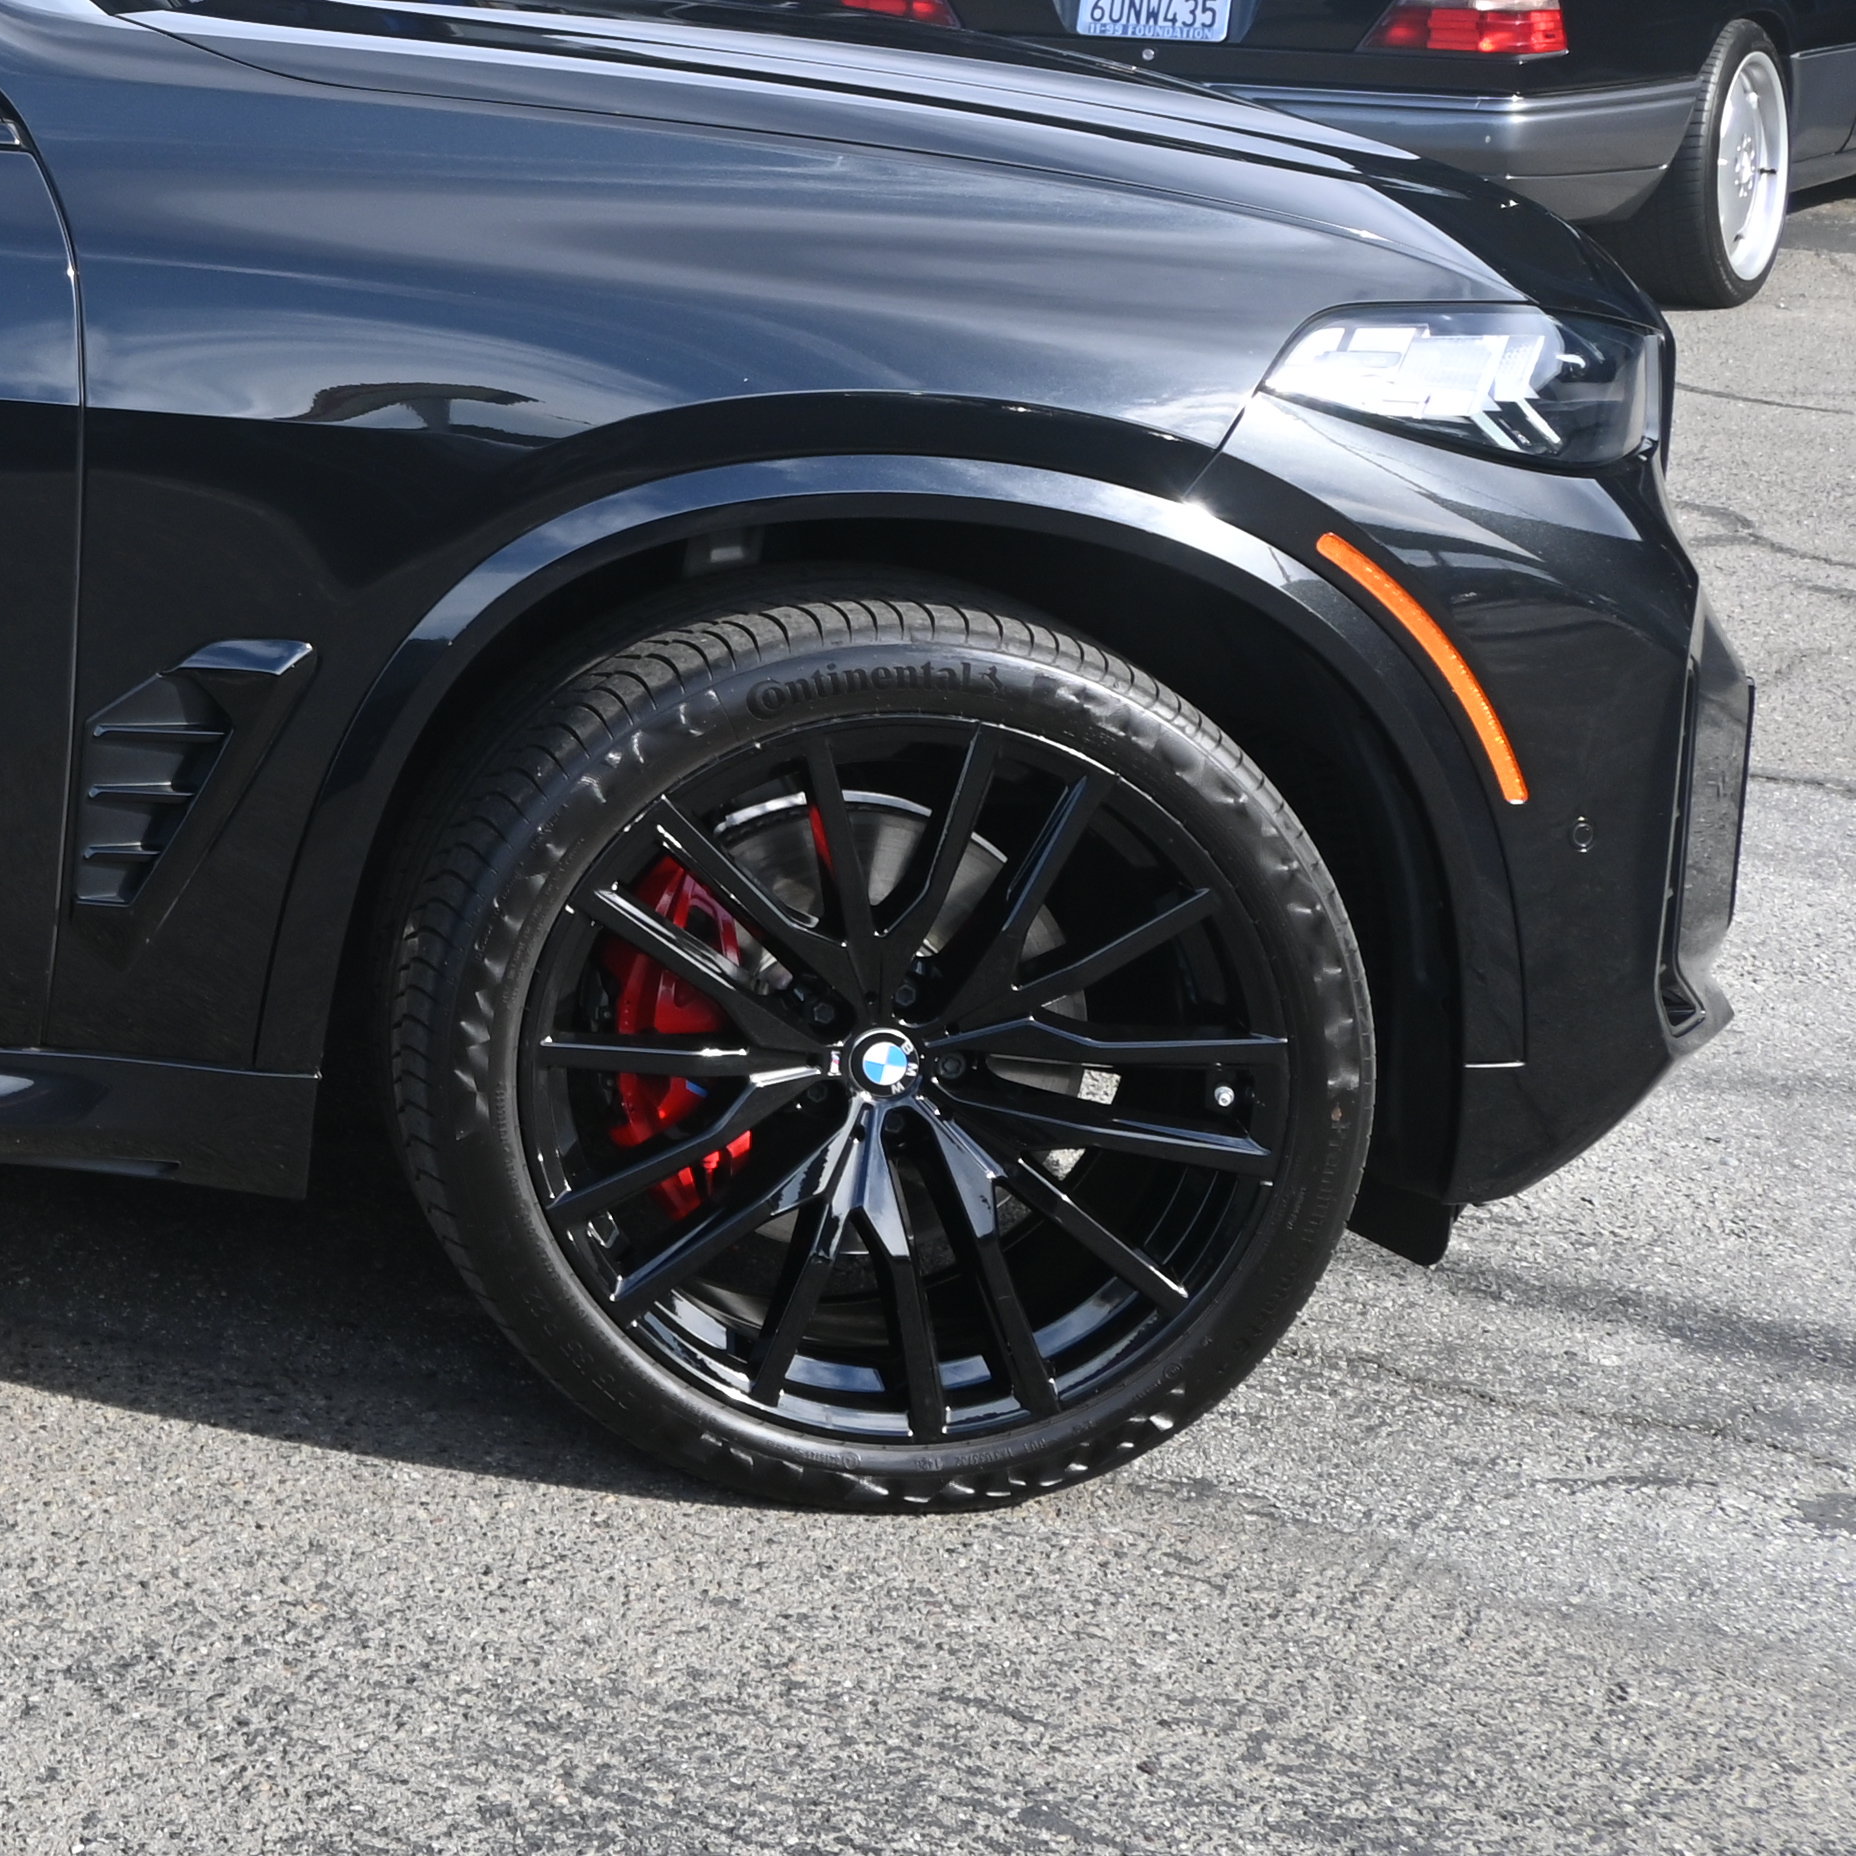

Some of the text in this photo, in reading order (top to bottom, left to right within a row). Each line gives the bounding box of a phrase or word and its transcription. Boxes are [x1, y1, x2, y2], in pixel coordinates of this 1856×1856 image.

[1089, 23, 1214, 39] 11-99 FOUNDATION
[745, 661, 973, 721] Continental
